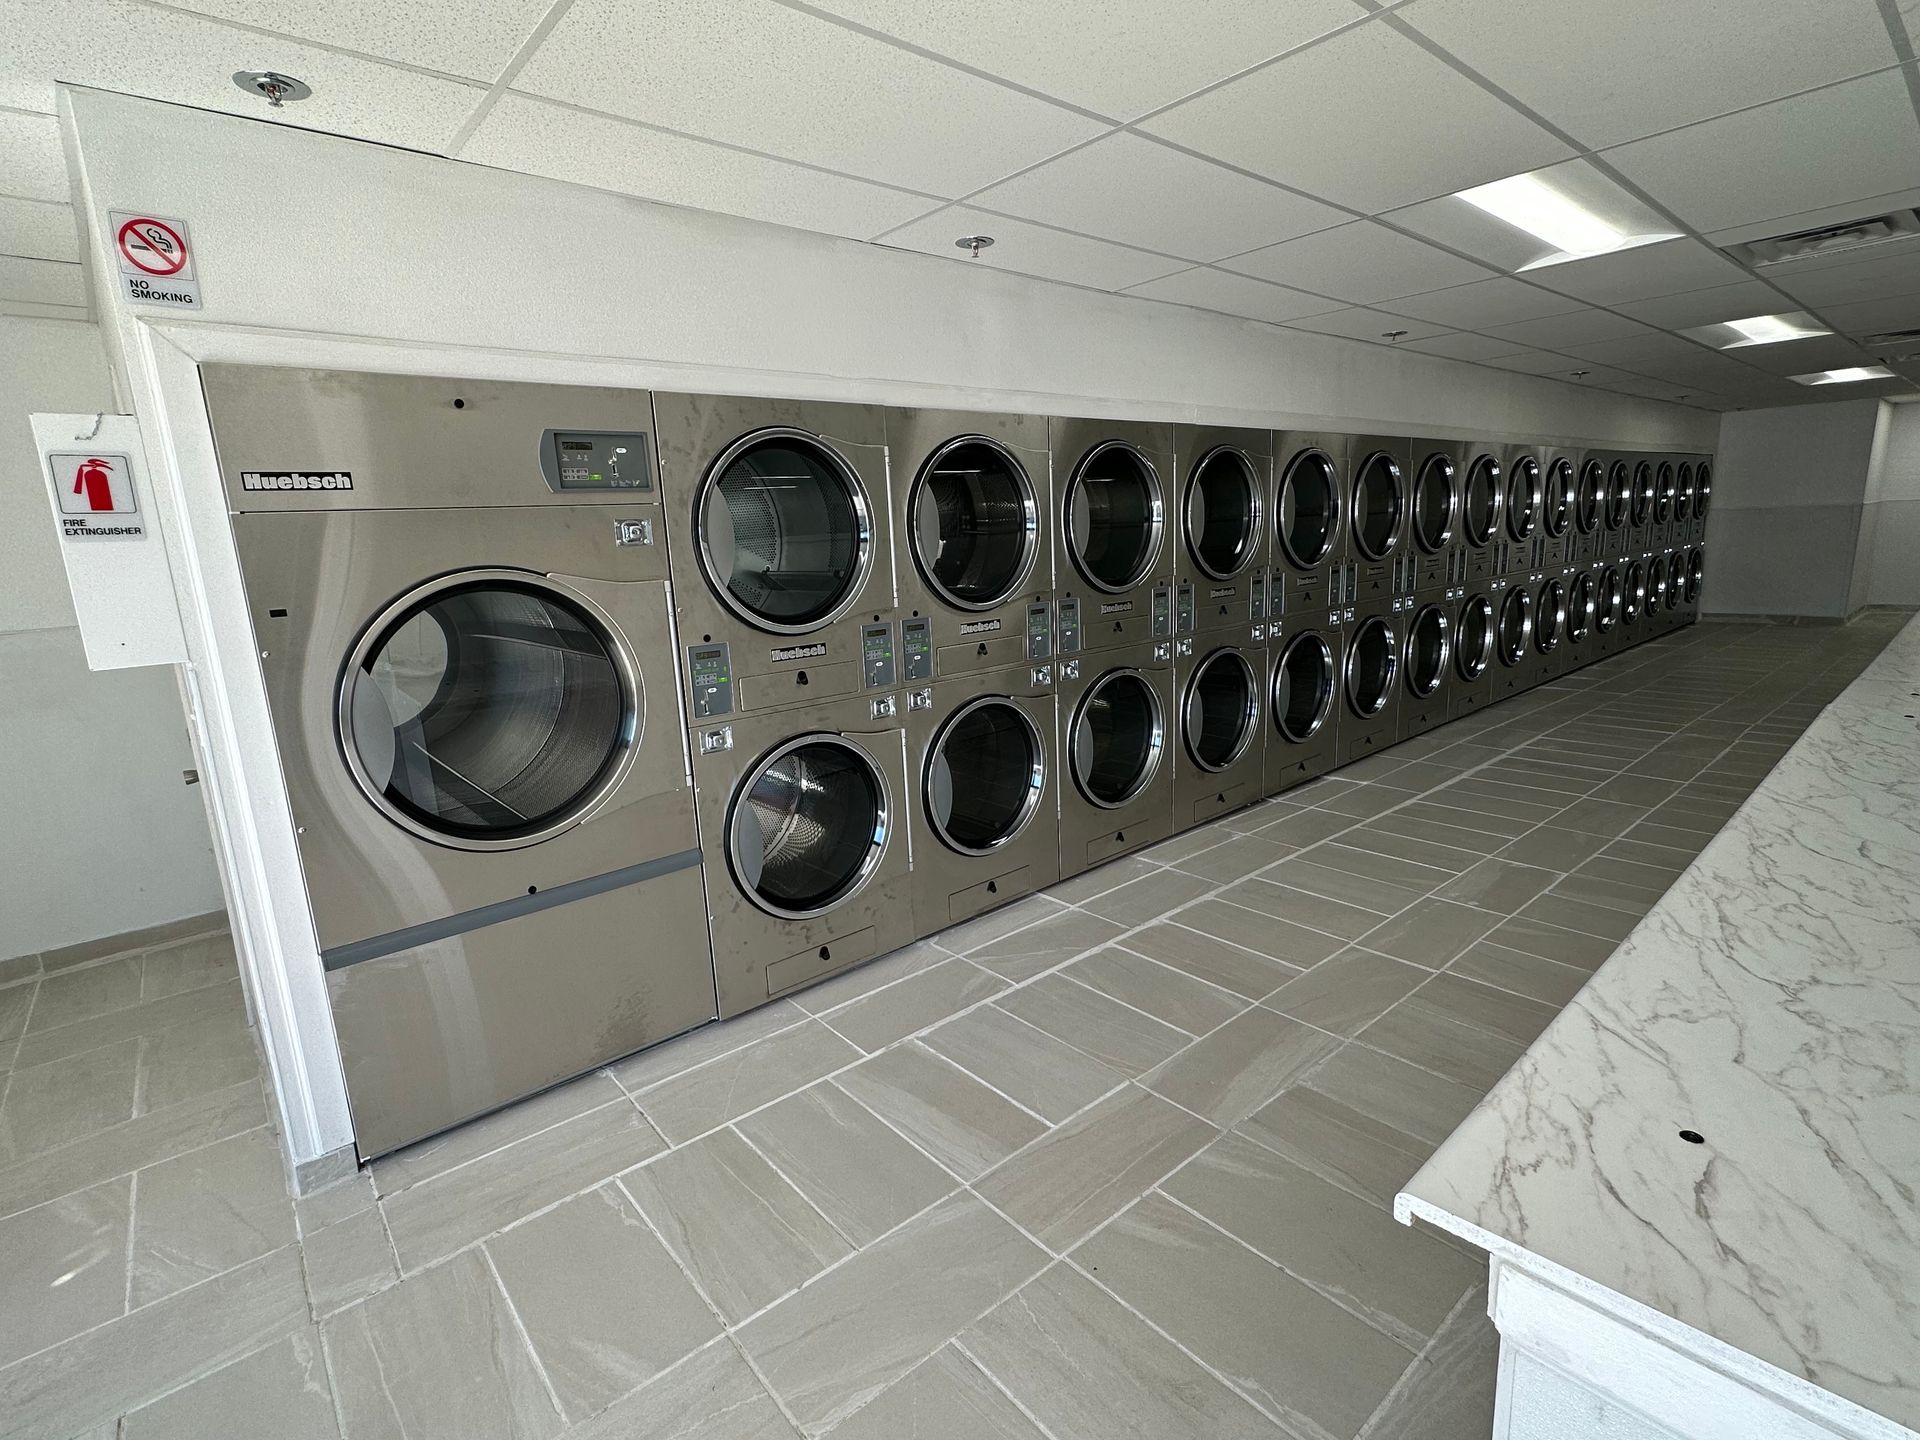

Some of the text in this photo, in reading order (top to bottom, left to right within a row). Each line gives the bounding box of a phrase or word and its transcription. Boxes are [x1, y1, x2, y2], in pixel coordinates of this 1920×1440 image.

[129, 279, 149, 290] NO
[131, 289, 193, 303] SMOKING
[243, 473, 352, 490] Huebsch
[63, 519, 87, 527] FIRE
[65, 527, 142, 536] EXTINGUISHER
[771, 643, 826, 662] Huebsch
